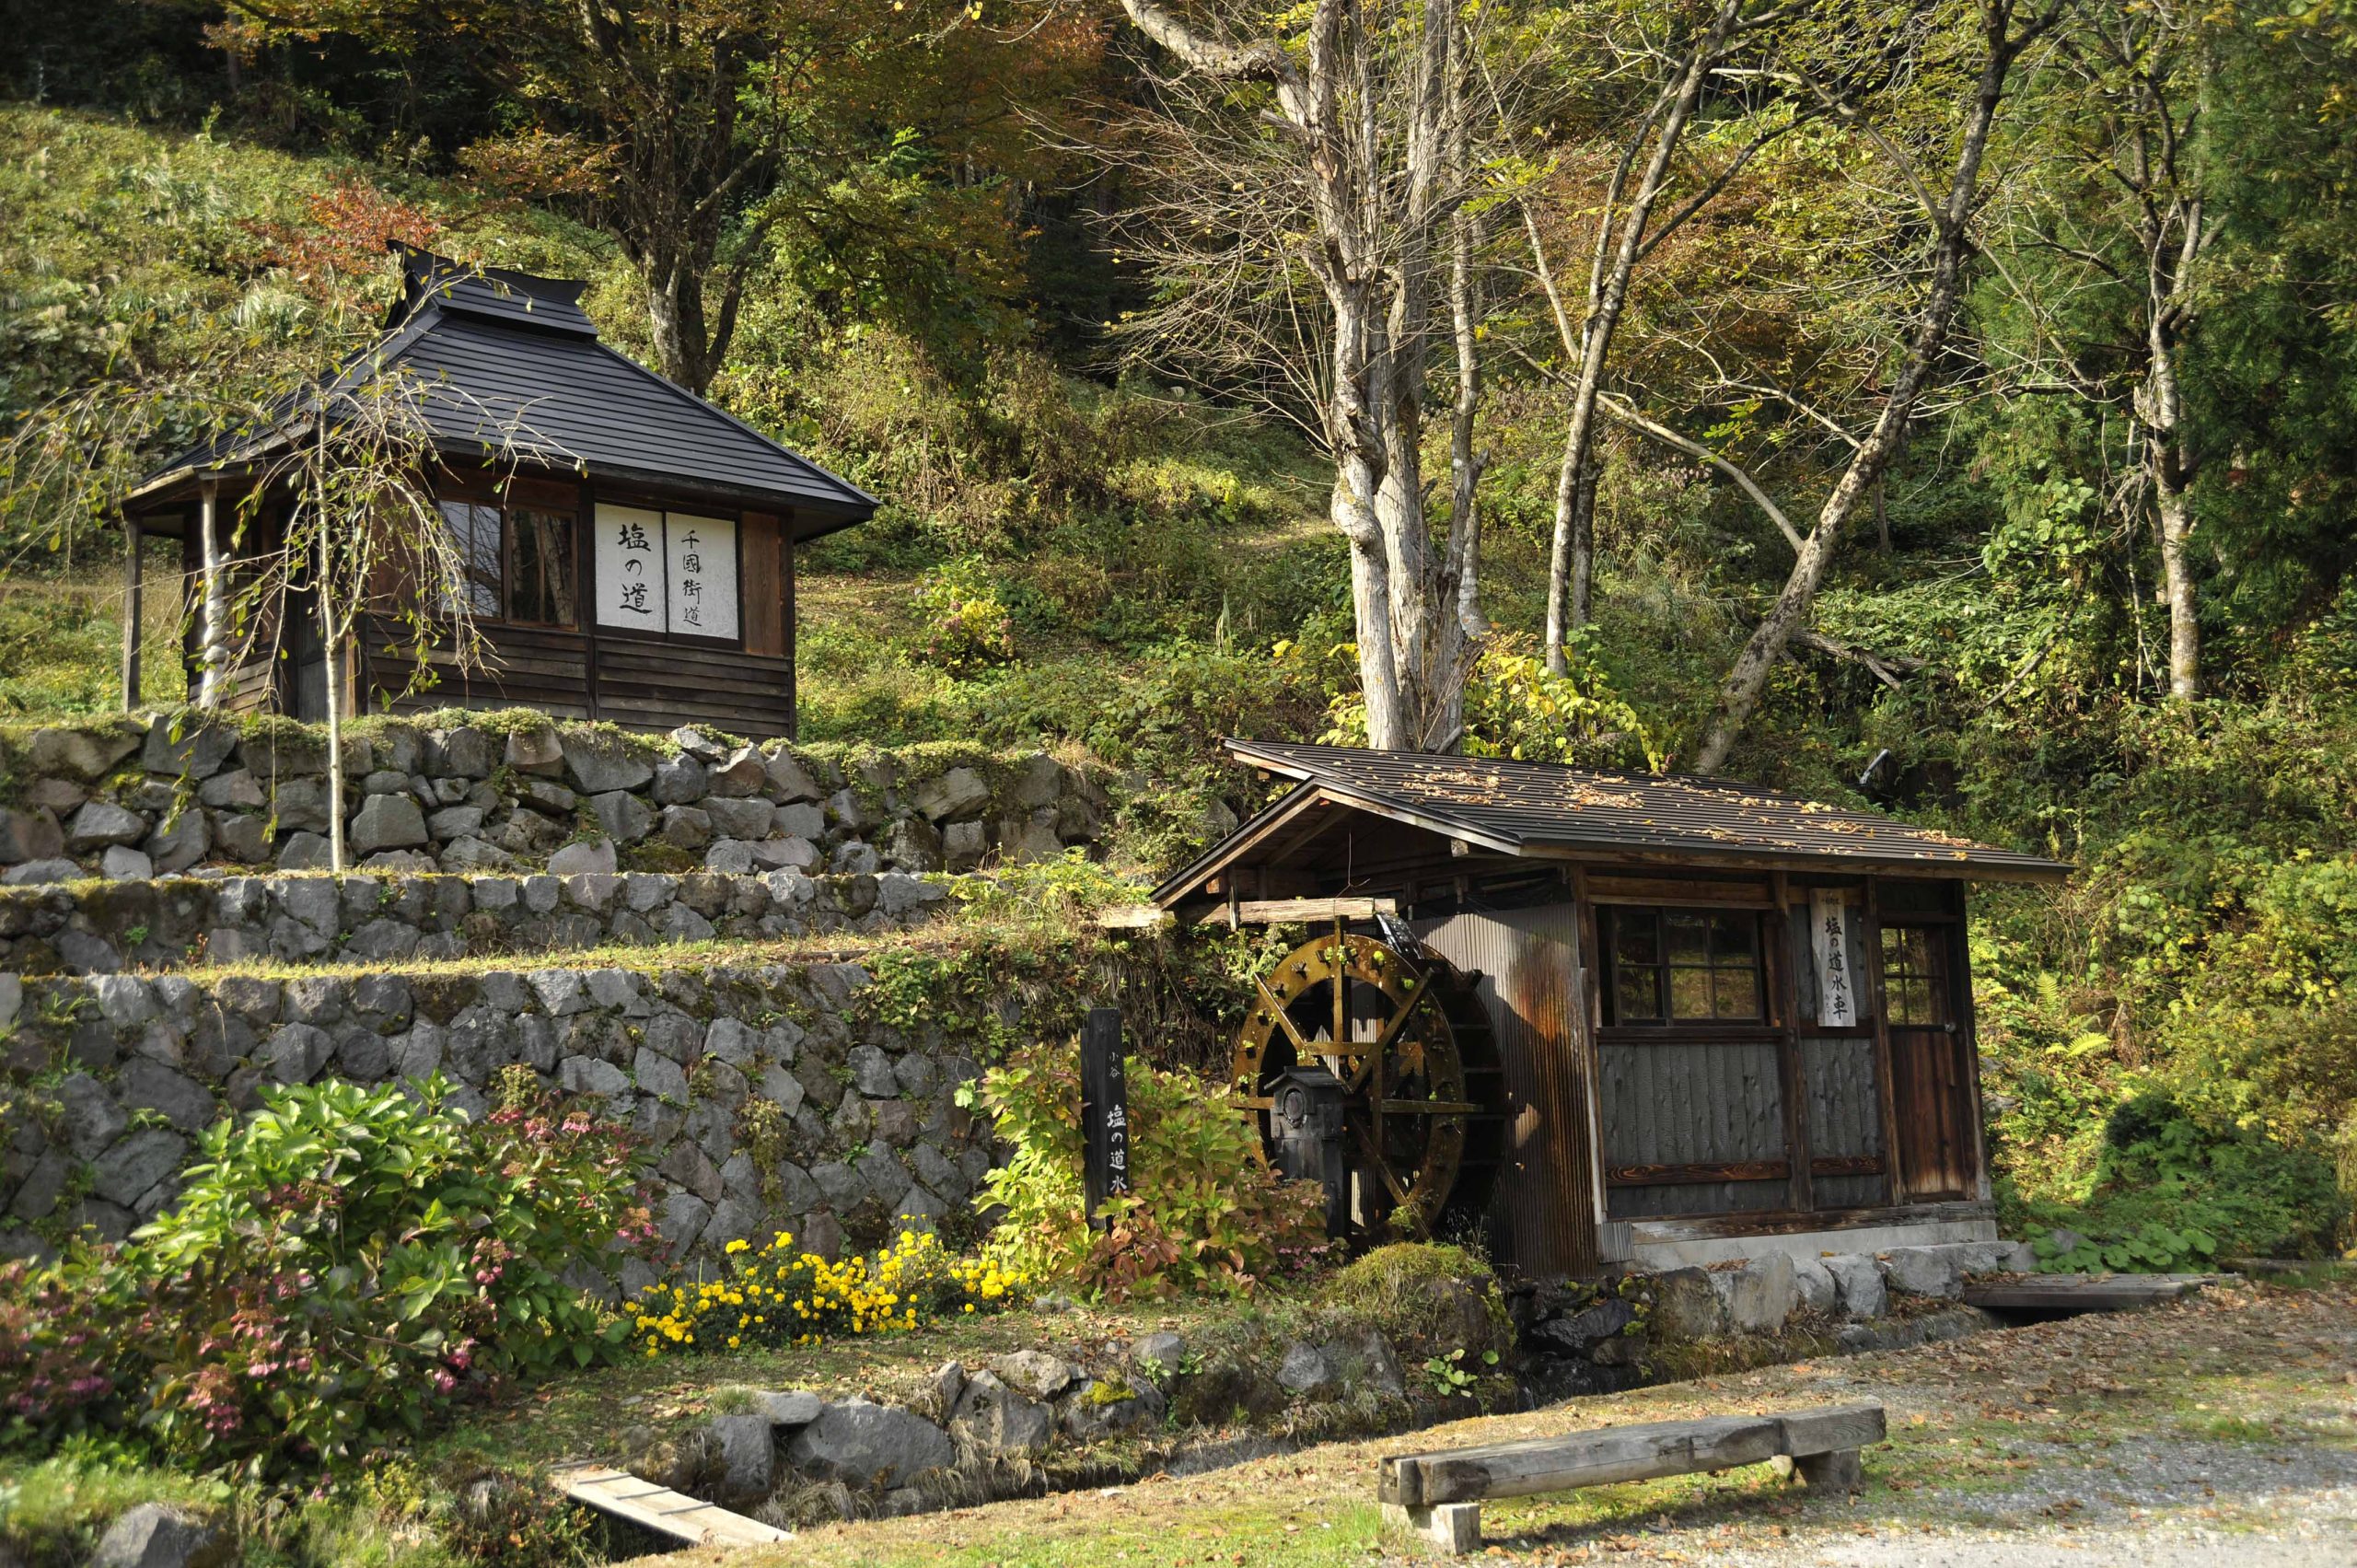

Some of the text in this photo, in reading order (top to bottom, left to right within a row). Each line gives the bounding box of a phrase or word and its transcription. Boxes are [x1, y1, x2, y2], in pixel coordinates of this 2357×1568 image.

[618, 523, 653, 615] 塩の道
[681, 529, 702, 627] 千國街道
[1825, 915, 1848, 1020] 塩の道水車
[1109, 1051, 1120, 1078] 小谷
